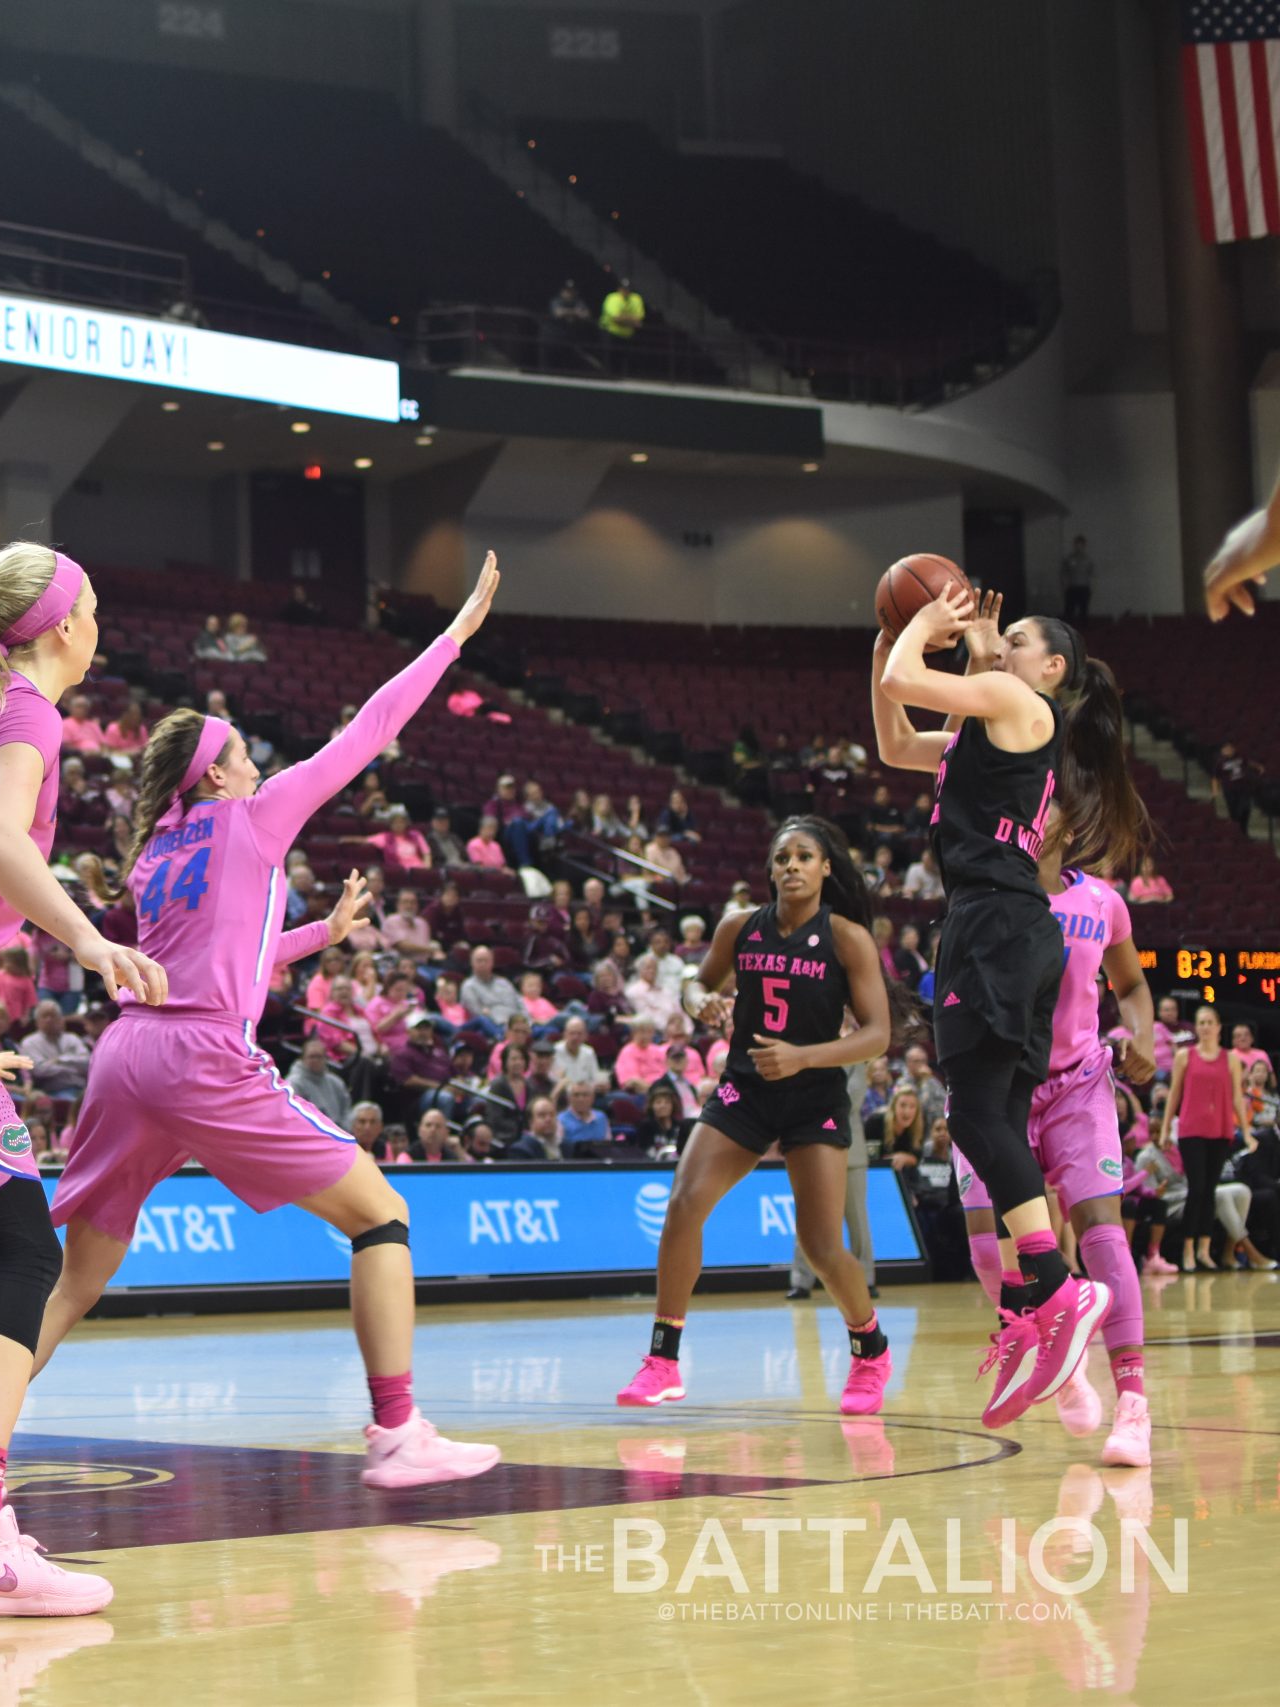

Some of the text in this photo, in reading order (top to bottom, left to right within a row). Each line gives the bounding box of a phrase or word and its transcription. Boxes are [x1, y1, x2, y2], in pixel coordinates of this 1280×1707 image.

[158, 3, 224, 38] 224
[550, 28, 620, 58] 225
[121, 325, 189, 377] DAY!
[140, 847, 212, 923] 44
[738, 953, 827, 980] TEXAS A&M
[1177, 949, 1227, 979] 8:21
[1238, 951, 1280, 969] FLORID
[762, 976, 790, 1033] 5
[1261, 976, 1280, 1002] 4
[133, 1205, 237, 1253] AT&T
[469, 1199, 559, 1244] AT&T
